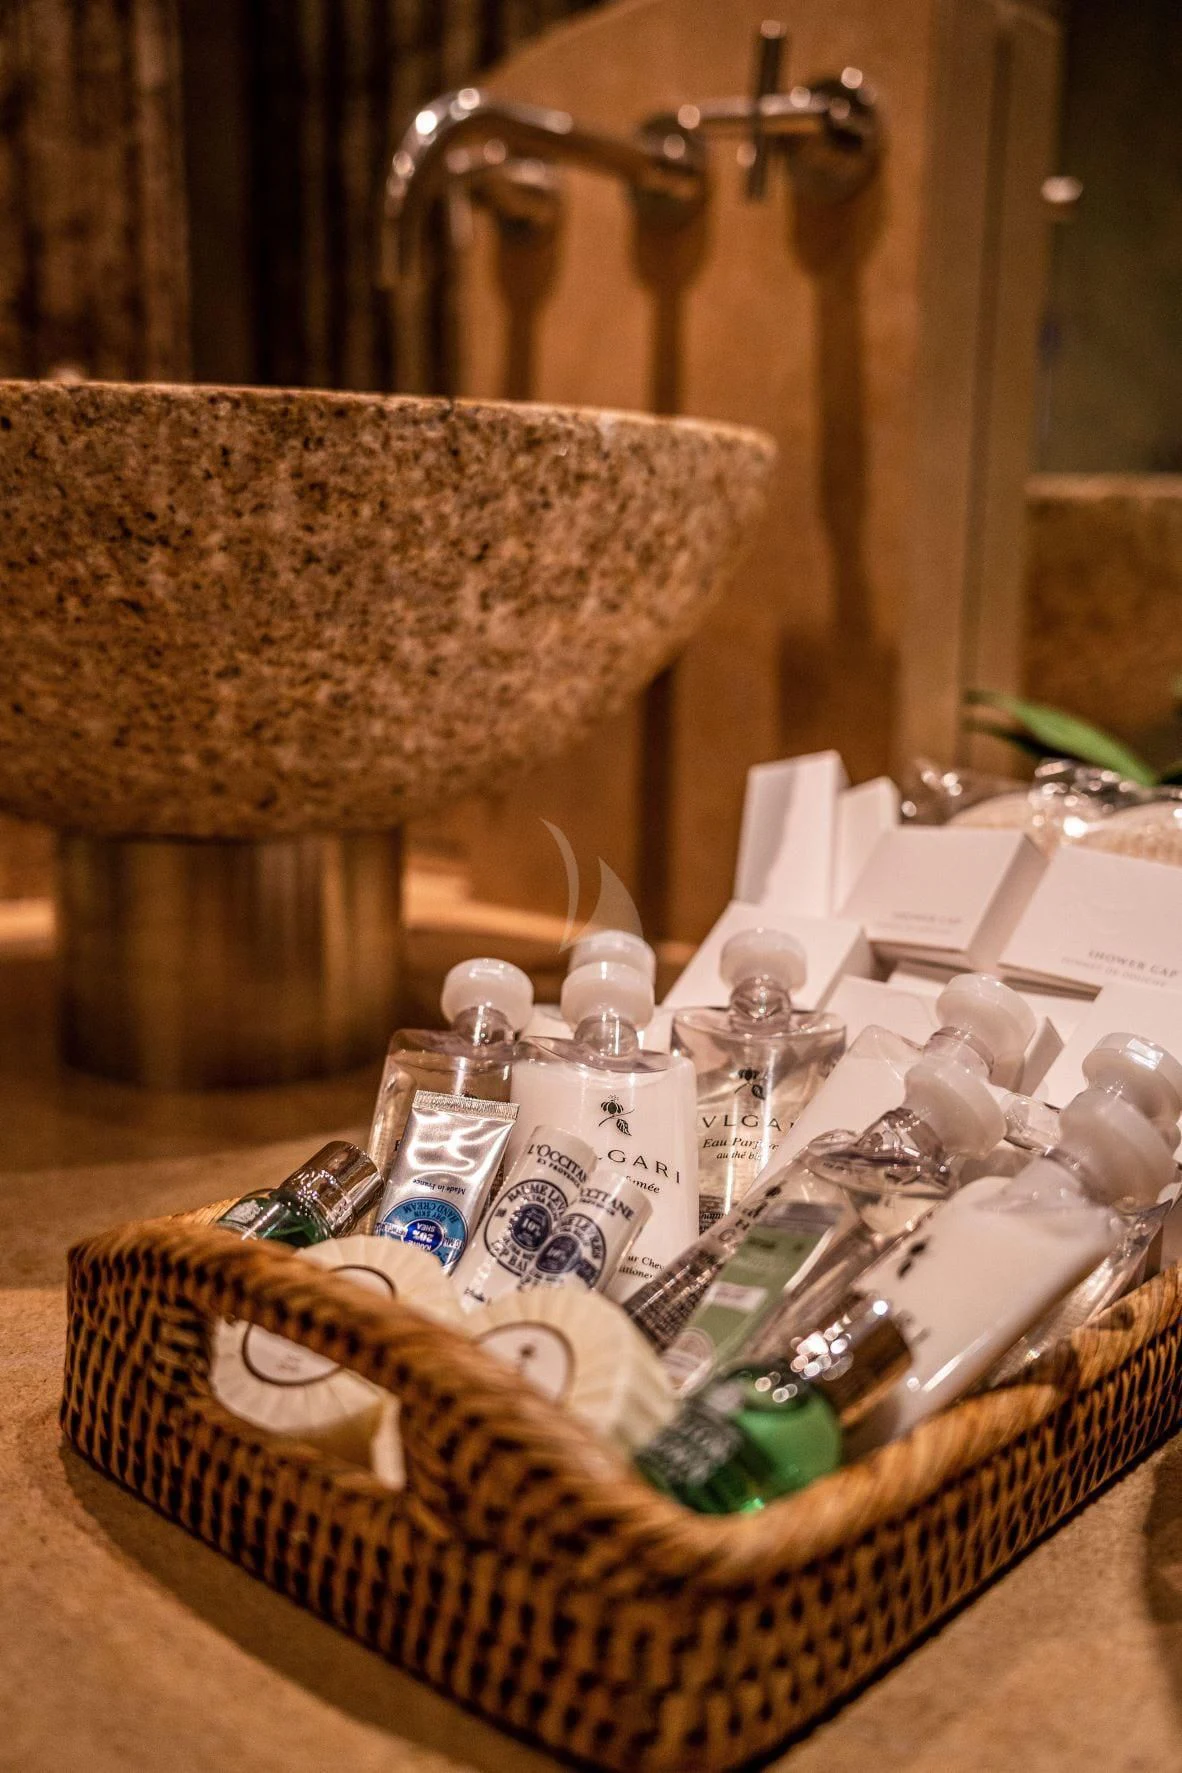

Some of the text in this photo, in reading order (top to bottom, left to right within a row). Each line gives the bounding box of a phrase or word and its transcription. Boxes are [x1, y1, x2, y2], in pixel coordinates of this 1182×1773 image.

[702, 1114, 794, 1132] VLGA
[703, 1138, 727, 1150] Eau
[716, 1151, 729, 1159] au
[731, 1149, 746, 1160] thé
[598, 1149, 680, 1184] GARI
[413, 1179, 436, 1190] France
[446, 1185, 466, 1195] Made
[402, 1201, 436, 1214] CREAM
[416, 1222, 436, 1232] SHEA
